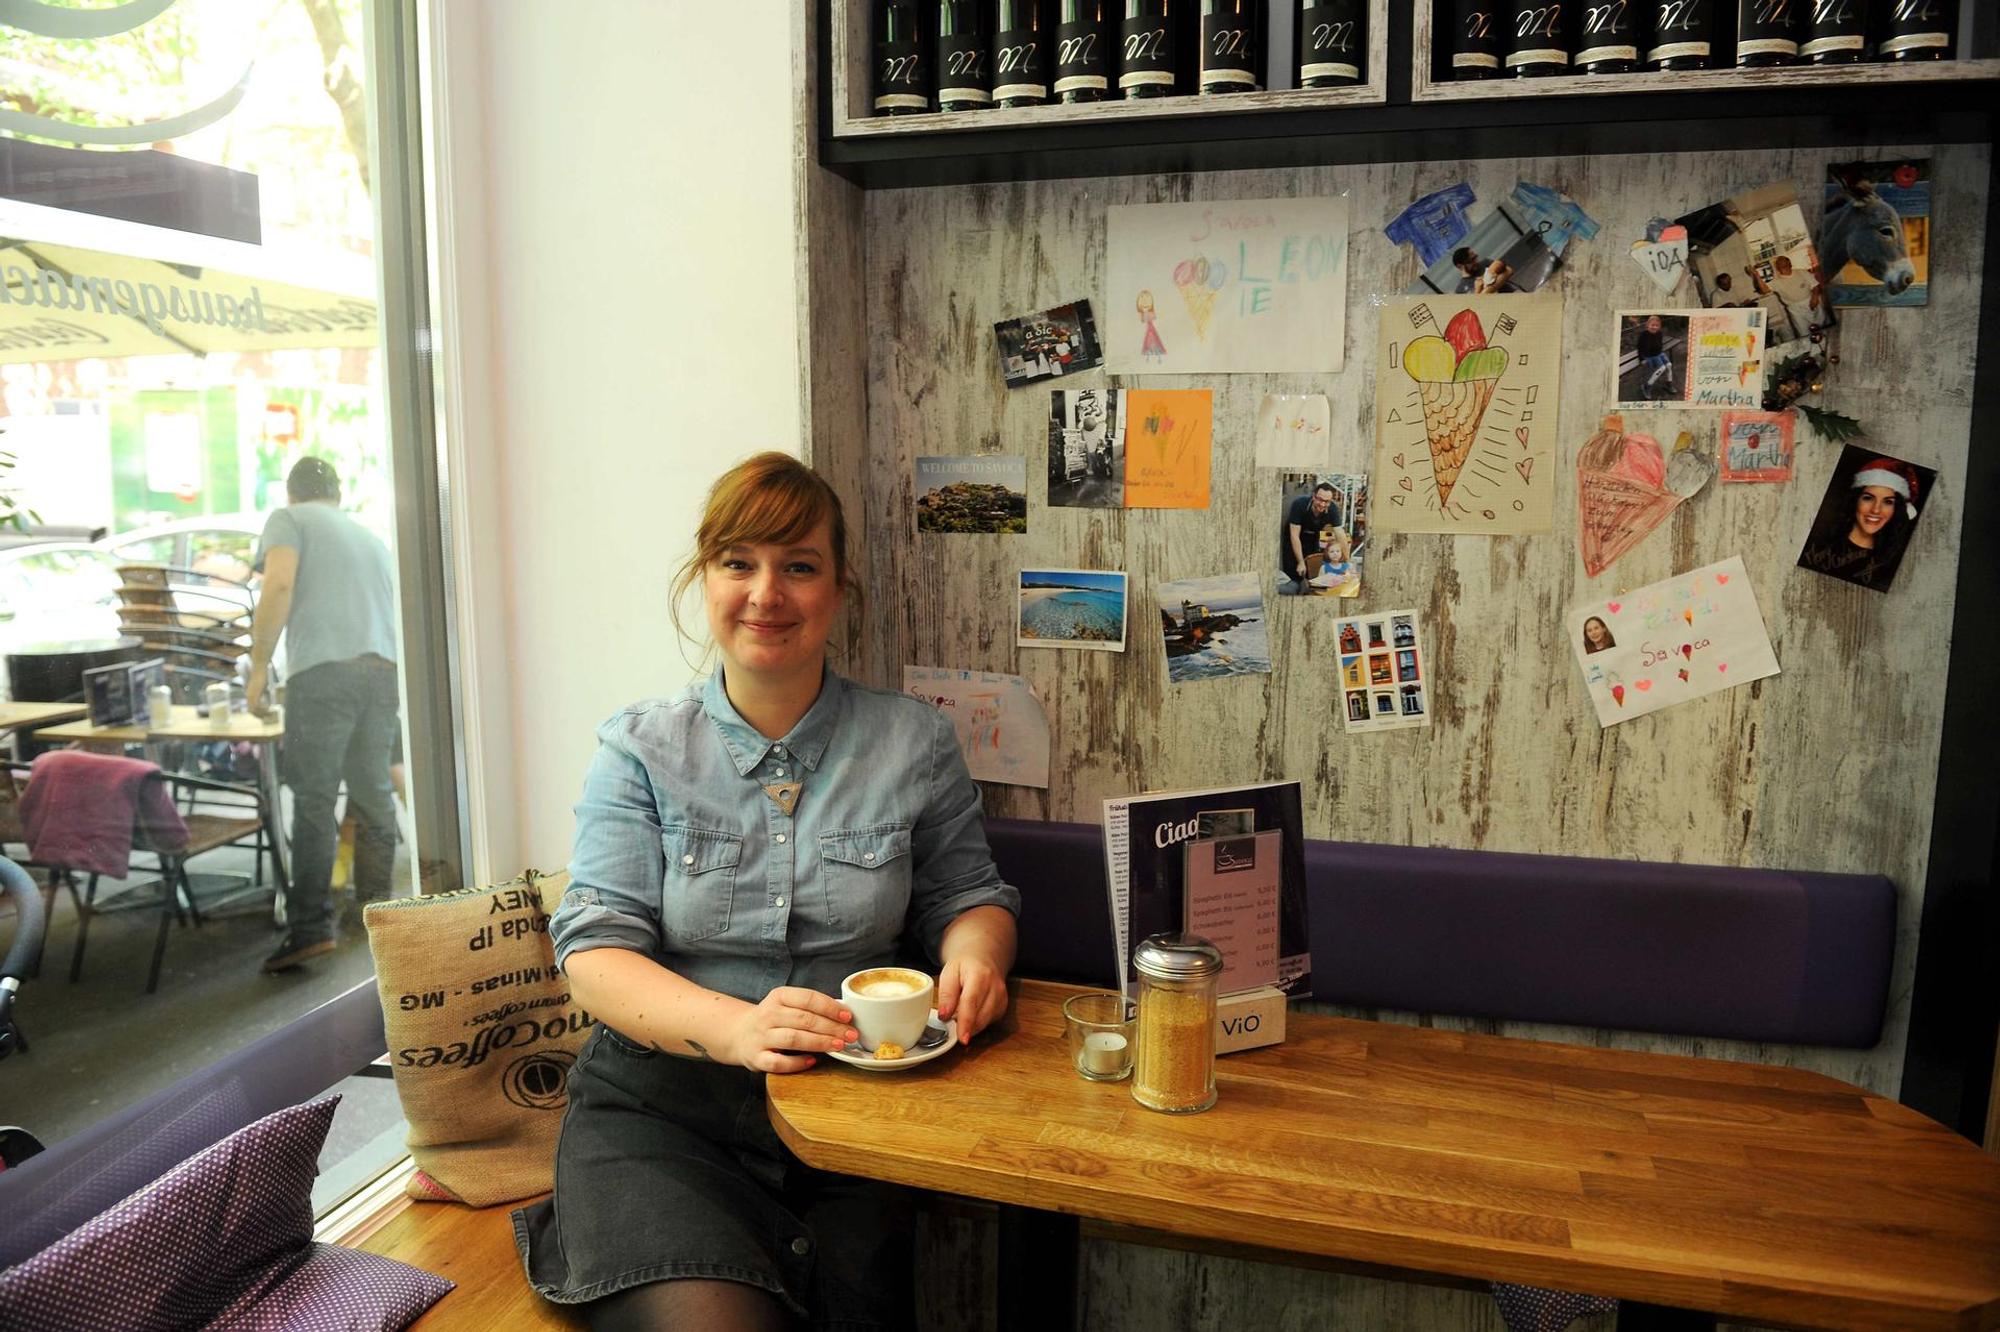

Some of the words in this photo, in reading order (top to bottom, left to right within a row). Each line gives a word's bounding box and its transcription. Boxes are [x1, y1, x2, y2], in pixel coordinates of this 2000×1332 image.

[921, 462, 969, 474] WELCOME
[1155, 818, 1198, 848] Ciao
[471, 968, 542, 996] Minas
[400, 984, 445, 1011] MG
[1222, 1015, 1258, 1036] ViO
